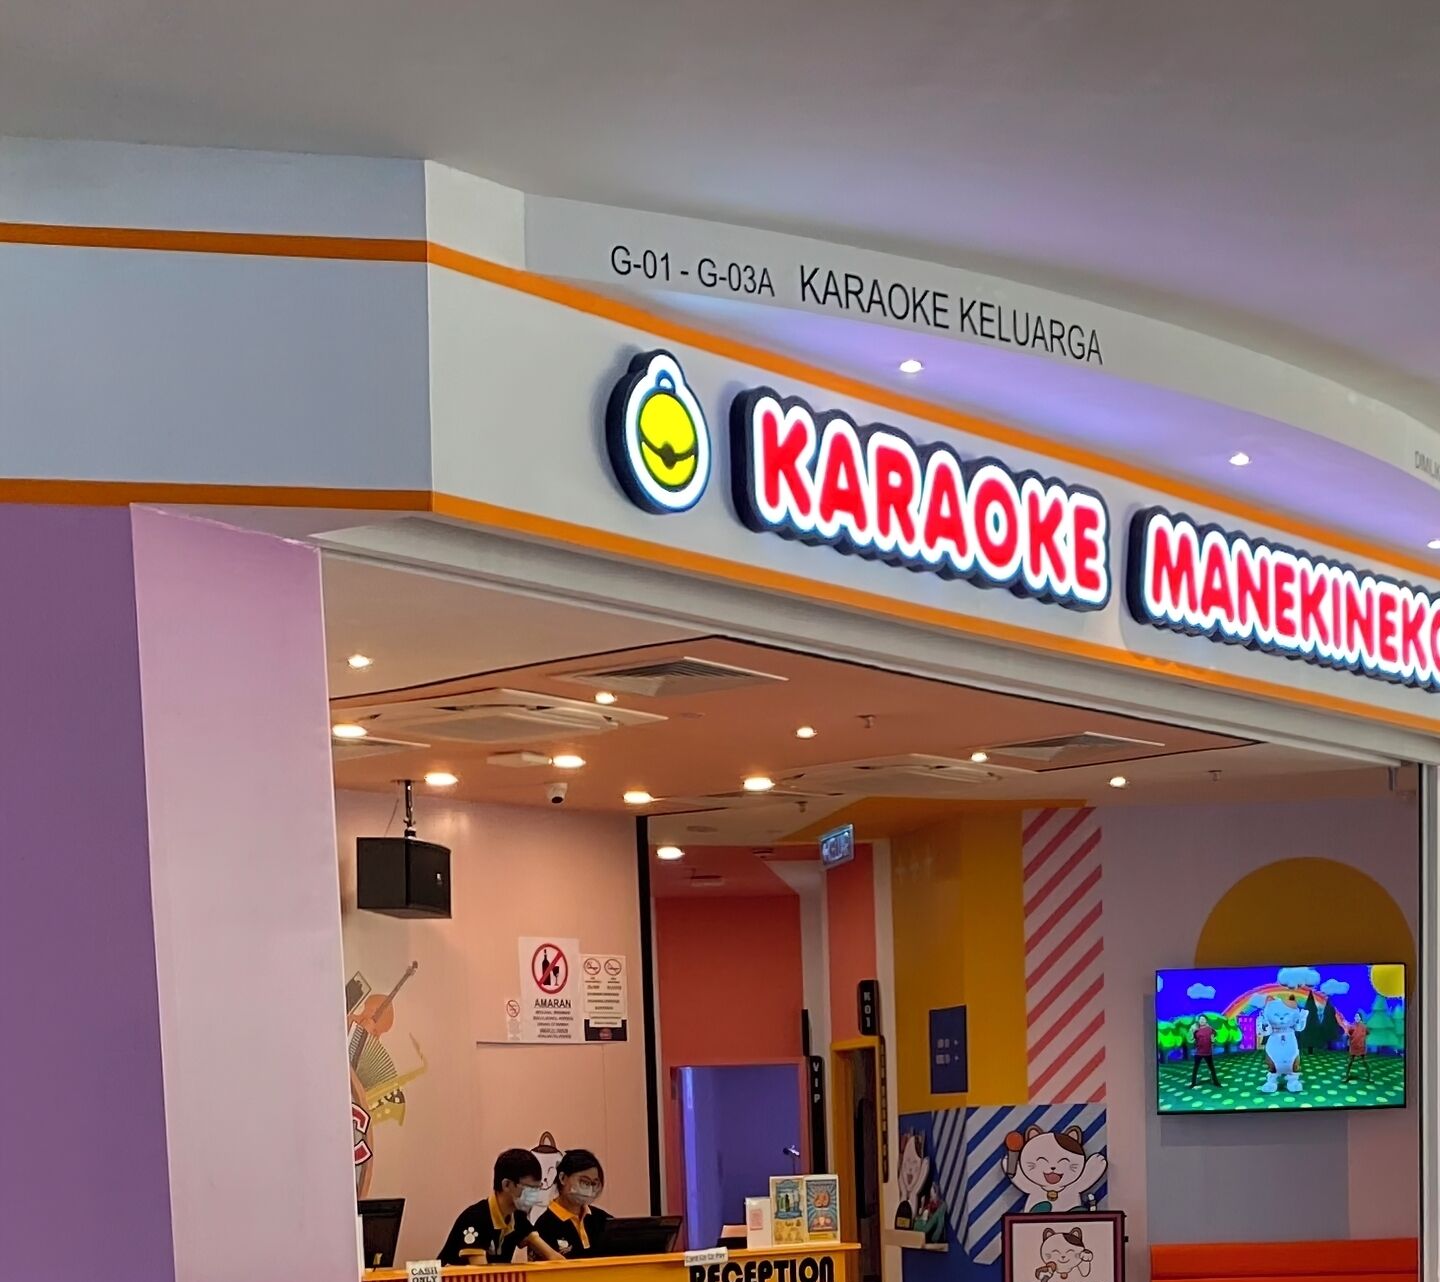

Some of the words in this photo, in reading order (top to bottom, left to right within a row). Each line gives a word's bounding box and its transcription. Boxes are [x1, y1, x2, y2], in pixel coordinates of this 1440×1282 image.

[610, 244, 672, 282] G-01
[697, 257, 776, 298] G-03A
[799, 263, 950, 330] KARAOKE
[958, 296, 1104, 366] KELUARGA
[755, 400, 1107, 600] KARAOKE
[533, 998, 571, 1009] AMARAN
[863, 991, 871, 1028] K01
[812, 1061, 821, 1104] VIP
[411, 1266, 438, 1276] CASH
